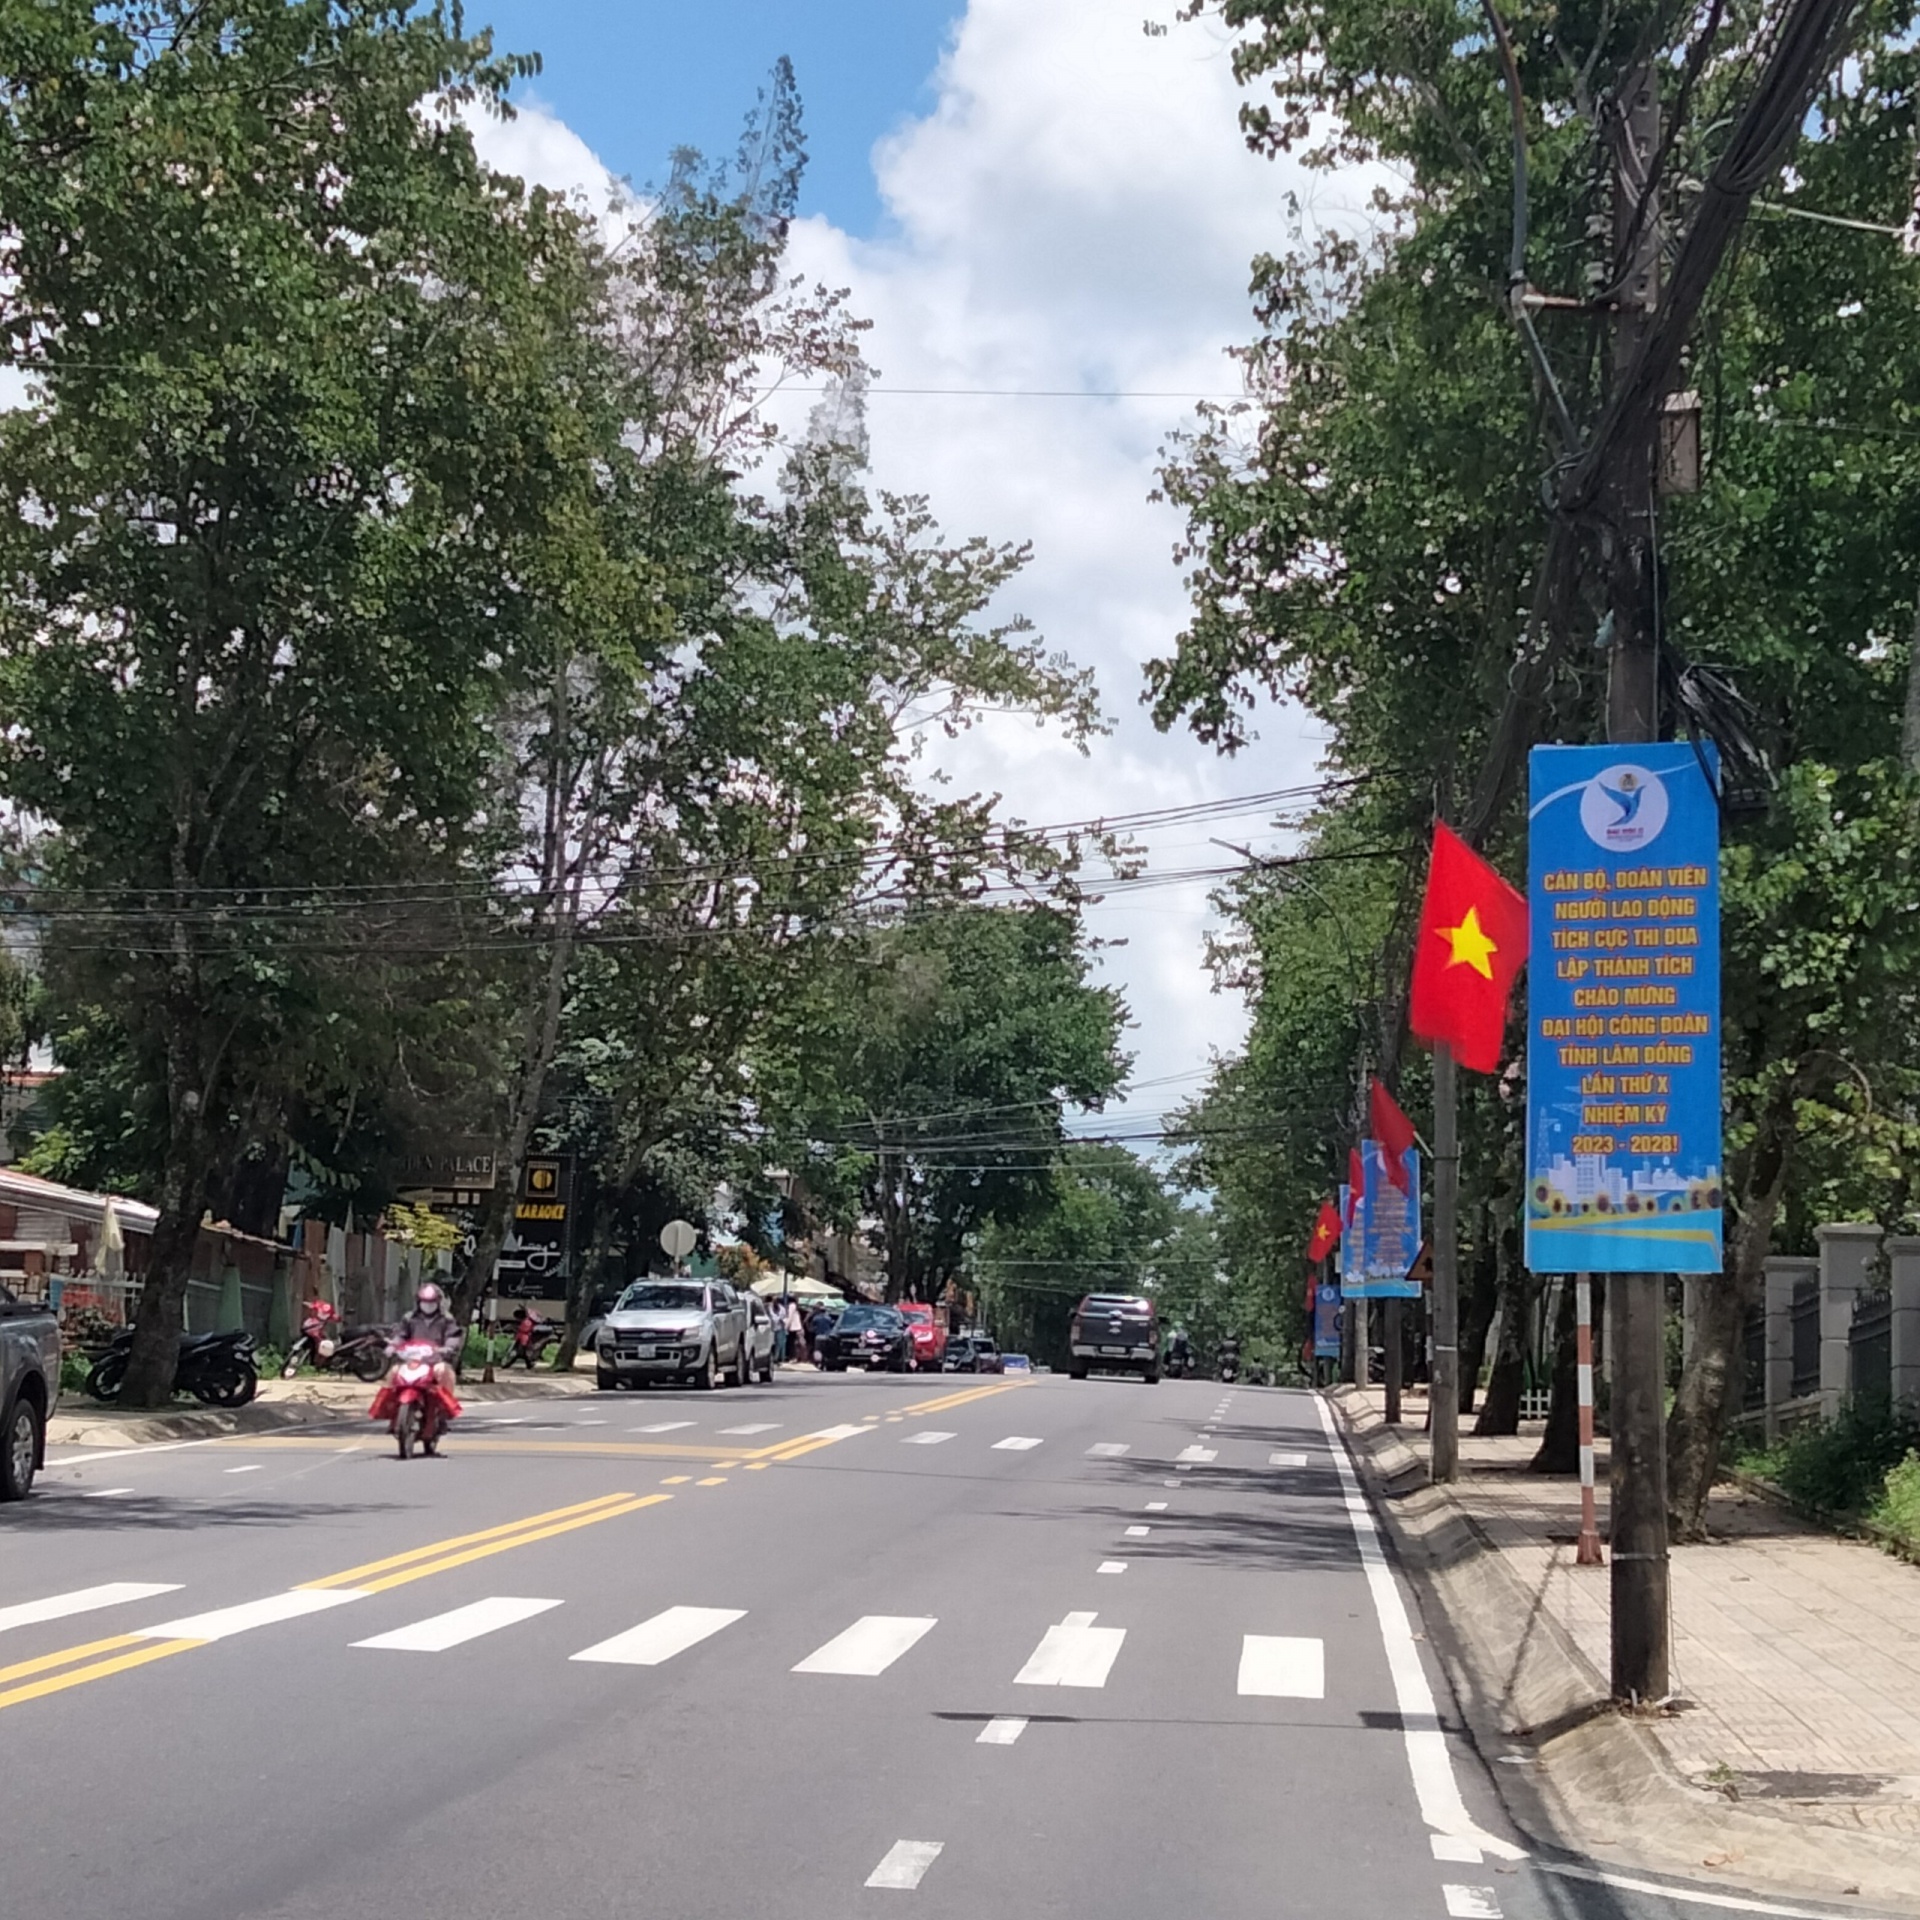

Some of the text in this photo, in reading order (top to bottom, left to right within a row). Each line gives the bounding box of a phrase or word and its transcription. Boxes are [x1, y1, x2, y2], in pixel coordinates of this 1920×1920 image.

[1668, 864, 1707, 886] VIÊN
[1611, 900, 1642, 918] LAO
[1648, 896, 1695, 920] ĐỘNG
[1633, 928, 1659, 946] THI
[1557, 957, 1589, 981] LẬP
[1575, 1015, 1603, 1039] HỘI
[1609, 1014, 1656, 1035] CÔNG
[1602, 1044, 1639, 1064] LÂM
[1657, 1075, 1668, 1093] X
[1572, 1136, 1614, 1153] 2023
[1630, 1135, 1679, 1153] 2028!
[515, 1203, 566, 1220] KARAOKE
